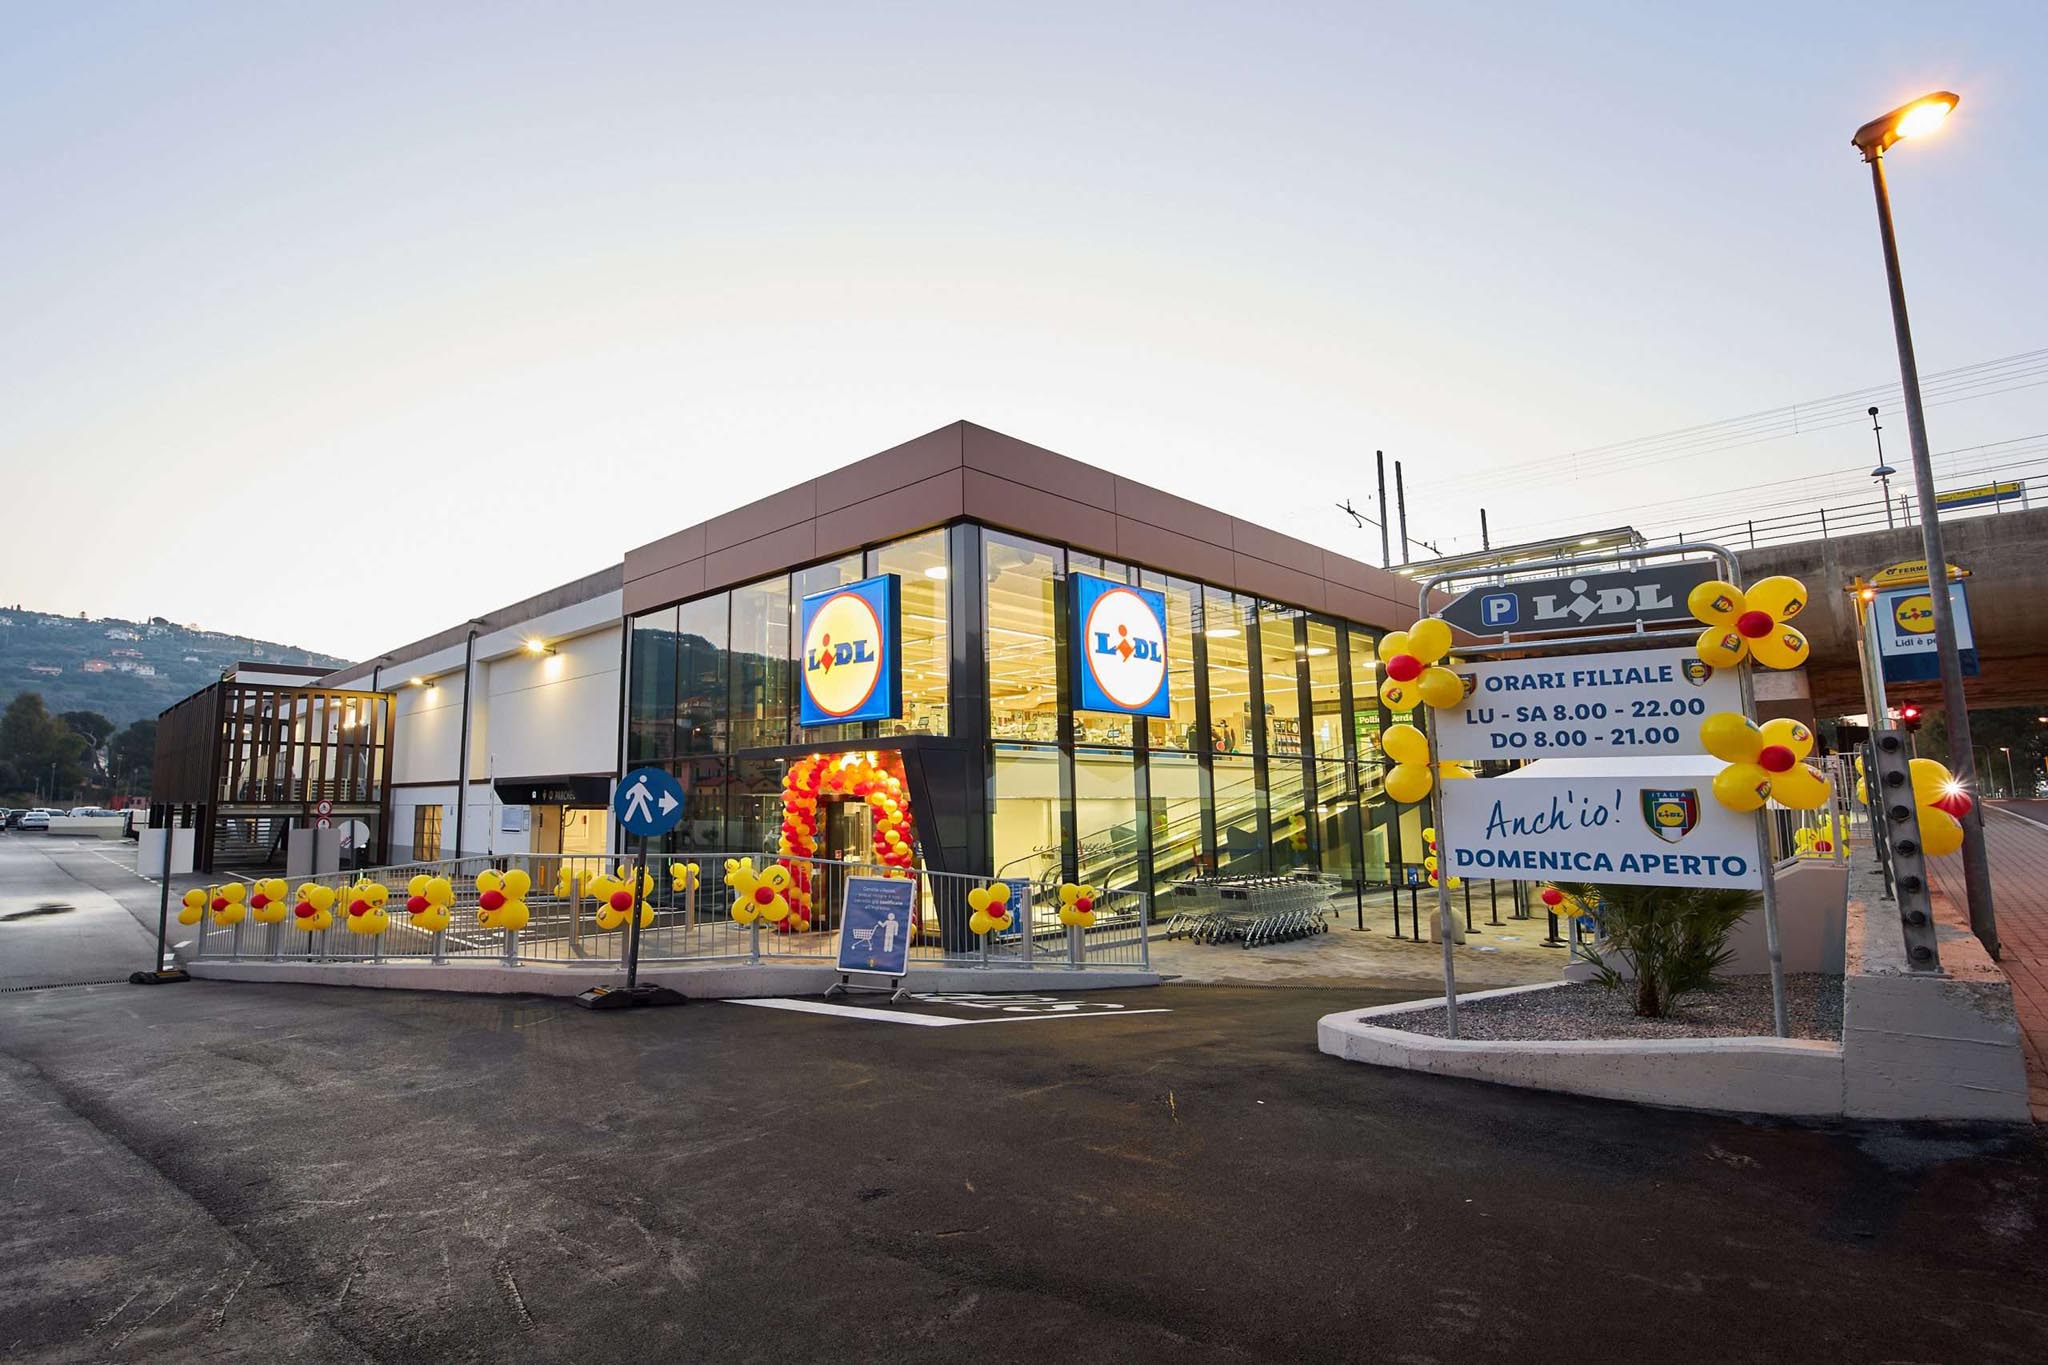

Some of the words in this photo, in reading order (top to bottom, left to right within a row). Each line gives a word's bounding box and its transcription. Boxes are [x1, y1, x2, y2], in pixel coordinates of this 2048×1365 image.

[1489, 598, 1511, 622] P
[1895, 638, 1914, 648] Lidl
[1485, 672, 1566, 692] ORARI
[1573, 665, 1673, 688] FILIALE
[1466, 708, 1494, 725] LU
[1516, 706, 1547, 722] SA
[1553, 703, 1607, 721] 8.00
[1631, 698, 1705, 718] 22.00
[1490, 732, 1527, 749] DO
[1534, 730, 1587, 748] 8.00
[1610, 726, 1680, 745] 21.00
[1485, 788, 1621, 840] Anch'io!
[1455, 848, 1614, 873] DOMENICA
[1619, 853, 1748, 877] APERTO
